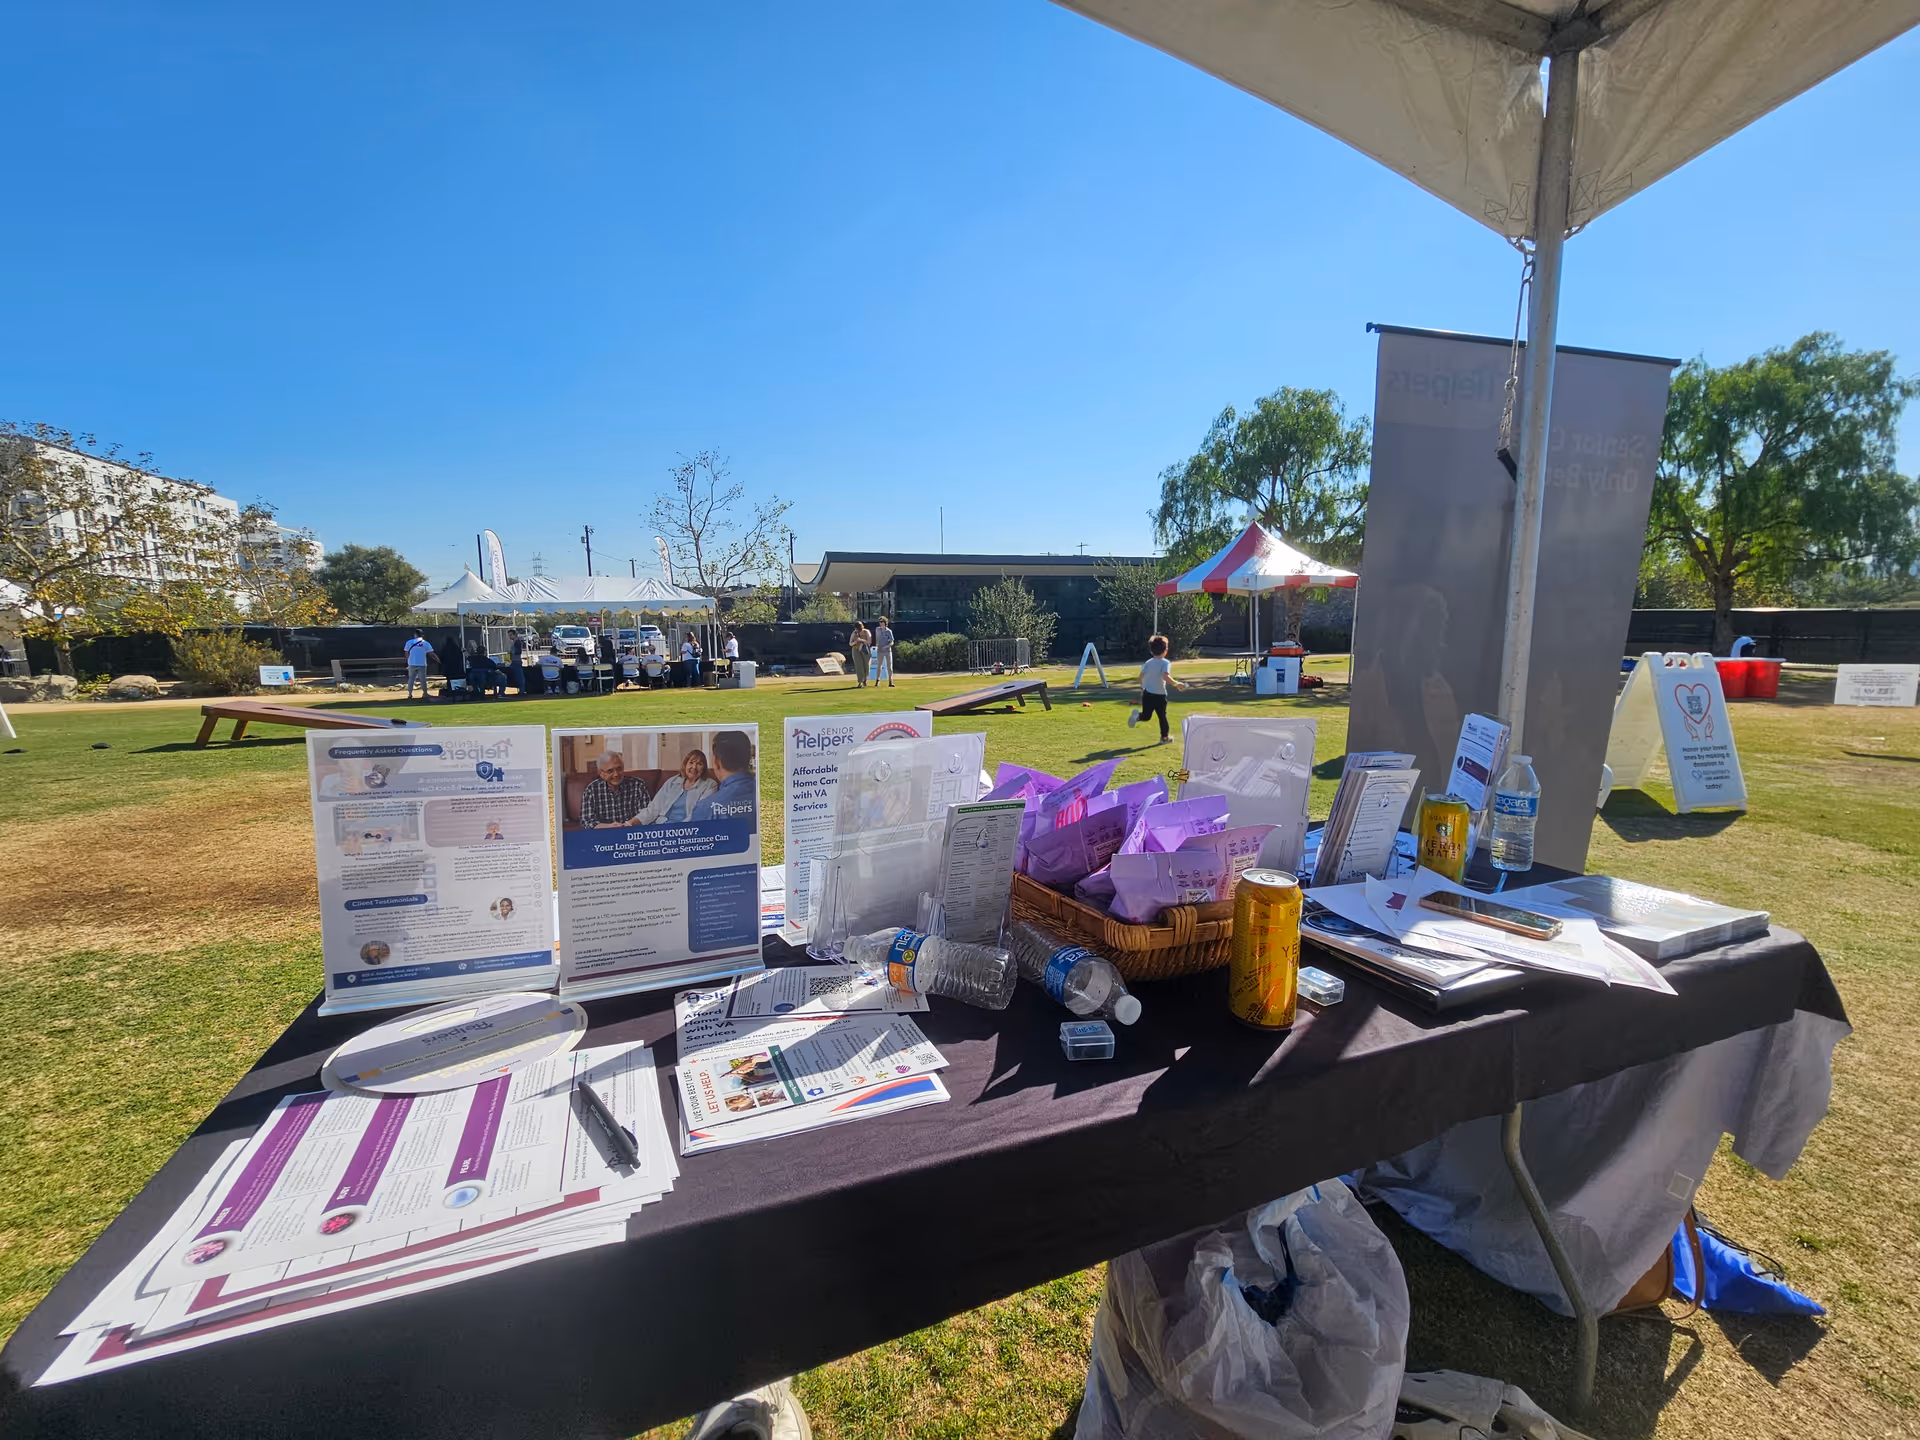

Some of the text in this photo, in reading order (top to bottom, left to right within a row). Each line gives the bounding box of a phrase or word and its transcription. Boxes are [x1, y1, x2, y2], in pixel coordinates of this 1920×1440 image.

[821, 727, 854, 736] SENIOR
[796, 733, 854, 751] Helpers
[793, 764, 838, 776] Affordable
[793, 791, 812, 799] with
[713, 804, 752, 816] Helpers
[793, 802, 828, 811] Services
[627, 827, 699, 841] DID YOU KNOW?
[594, 844, 614, 852] Your
[615, 841, 659, 852] Long-Term
[678, 836, 714, 844] Insurance
[613, 851, 636, 859] Cover
[638, 849, 659, 857] Home
[681, 843, 715, 852] Services?
[375, 896, 418, 904] Testimonials
[685, 1018, 719, 1027] Home
[422, 1020, 489, 1044] Helpers
[685, 1025, 712, 1034] with
[686, 1030, 736, 1042] Services
[683, 1069, 703, 1122] LIVE YOUR BEST LIFE.
[700, 1069, 720, 1114] LET US HELP.
[460, 1154, 472, 1174] PEARL
